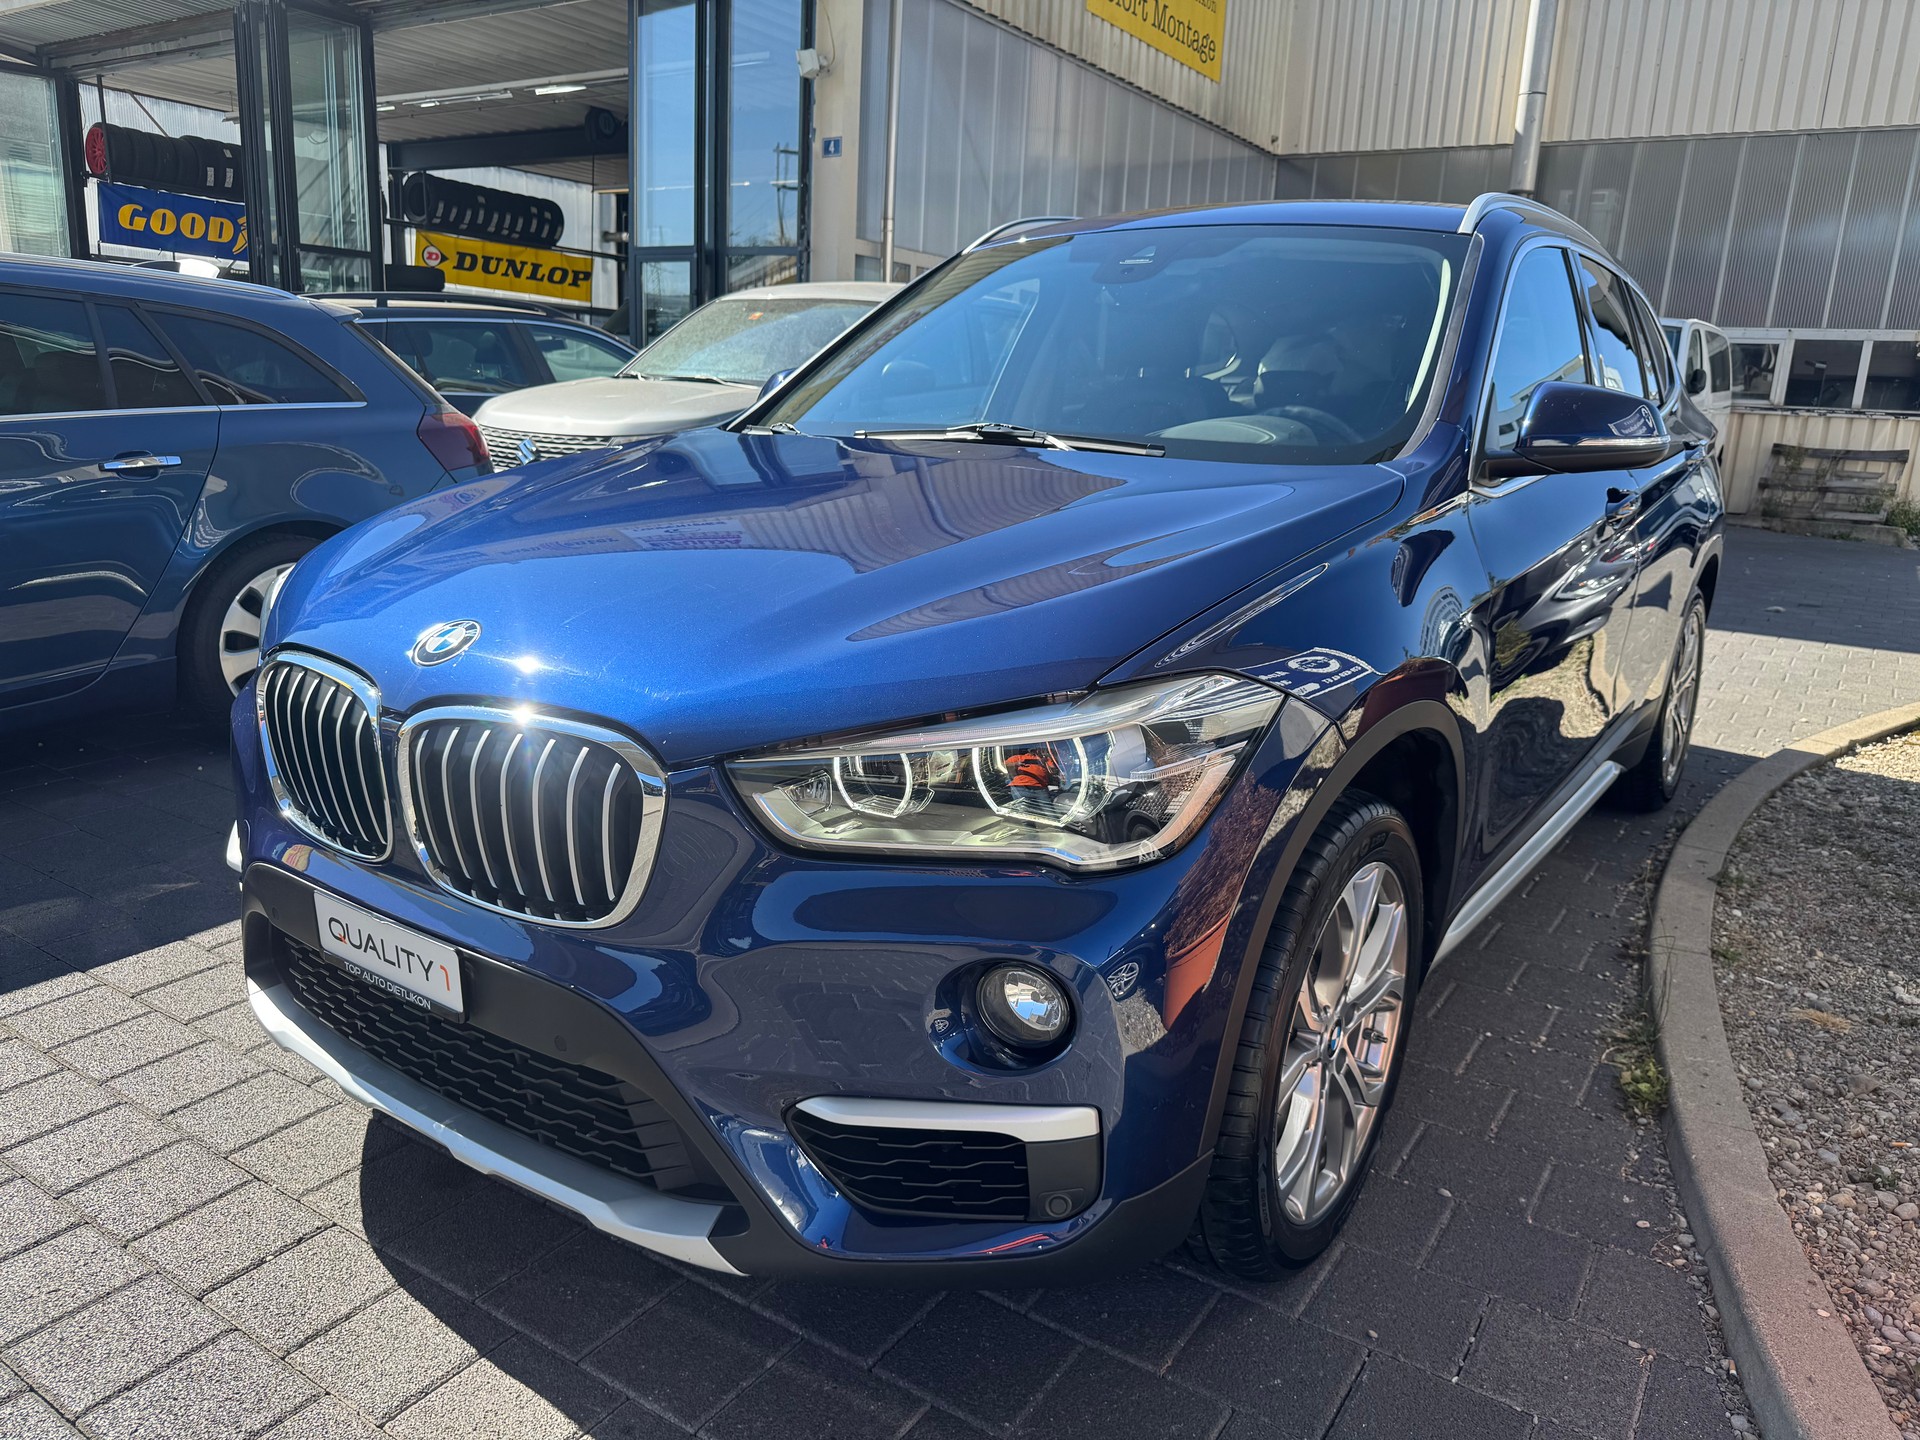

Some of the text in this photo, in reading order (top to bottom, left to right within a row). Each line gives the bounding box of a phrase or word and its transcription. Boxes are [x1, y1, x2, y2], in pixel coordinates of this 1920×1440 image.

[1151, 0, 1216, 64] Montage
[452, 251, 592, 288] DUNLOP
[328, 916, 451, 992] QUALITY 1
[344, 961, 431, 1010] TOP AUTO DIETLIKON
